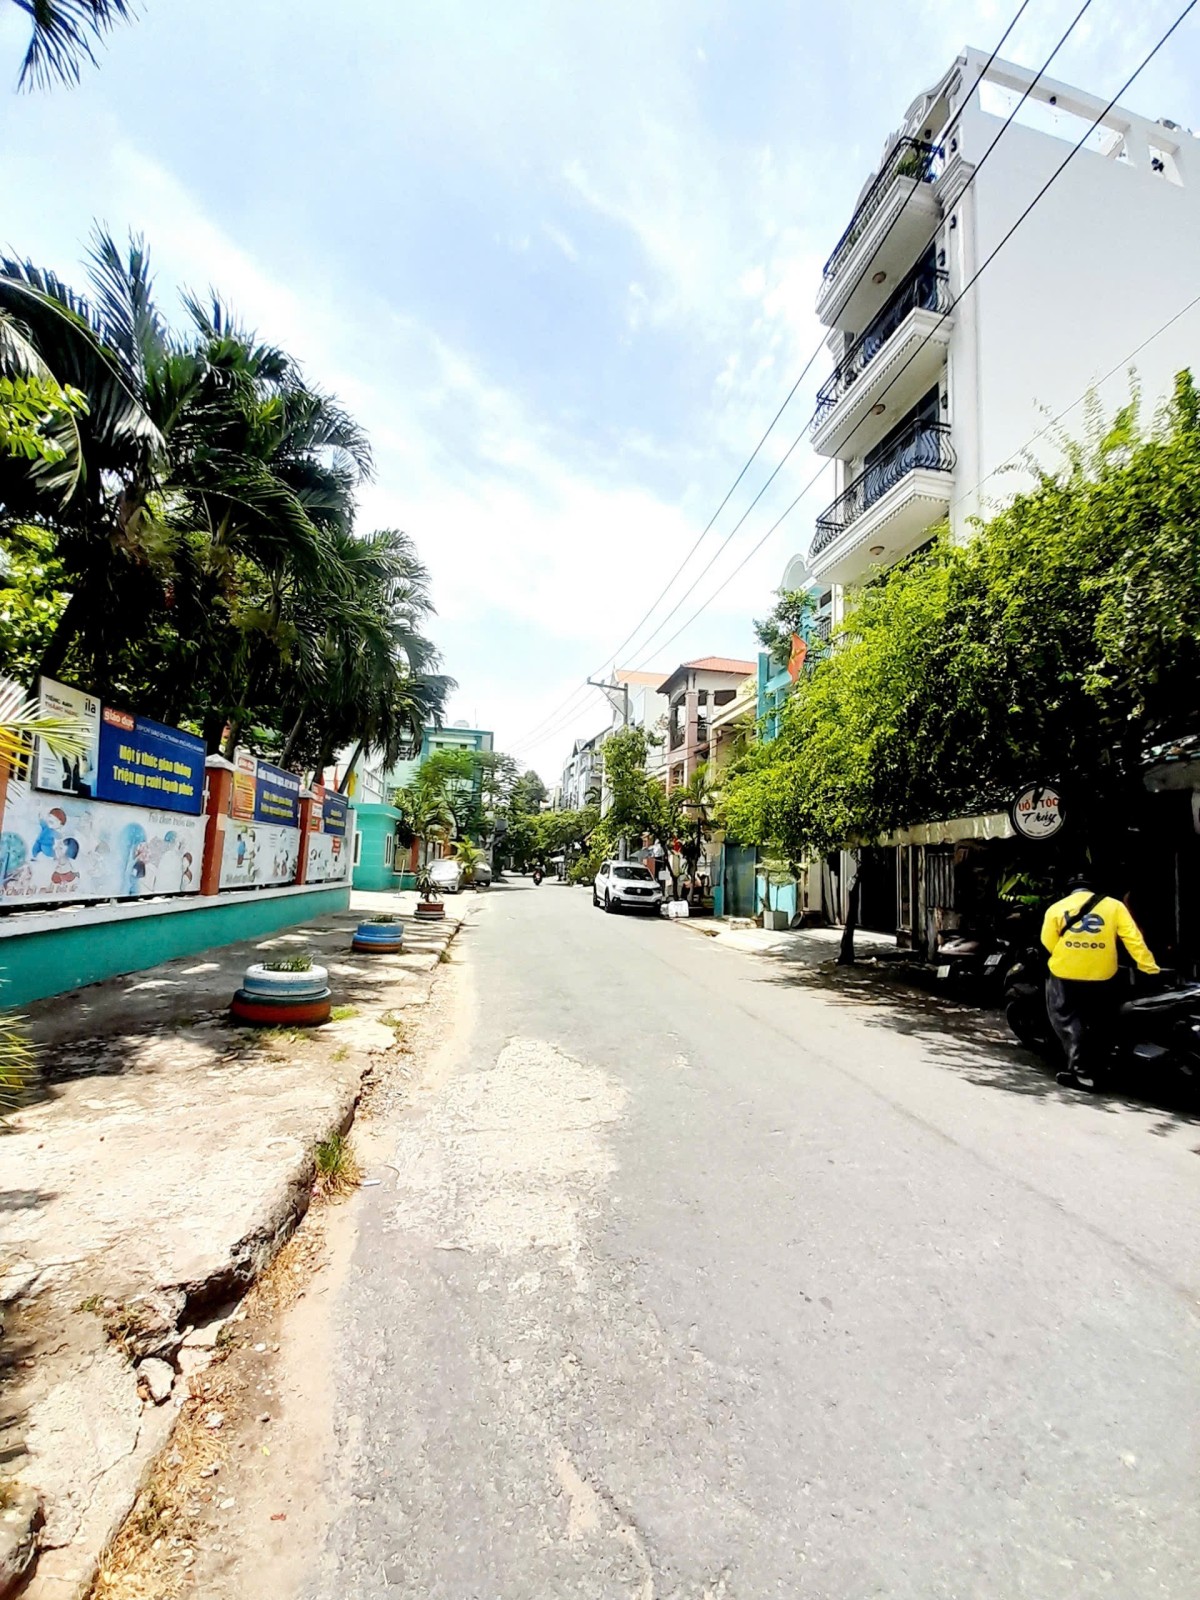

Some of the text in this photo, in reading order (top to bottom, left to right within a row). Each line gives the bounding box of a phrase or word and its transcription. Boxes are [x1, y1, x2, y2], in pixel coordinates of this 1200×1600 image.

[84, 697, 96, 714] ila
[120, 744, 135, 764] Một
[136, 749, 141, 765] ý
[113, 765, 135, 785] Triệu
[1018, 799, 1037, 811] UỐ
